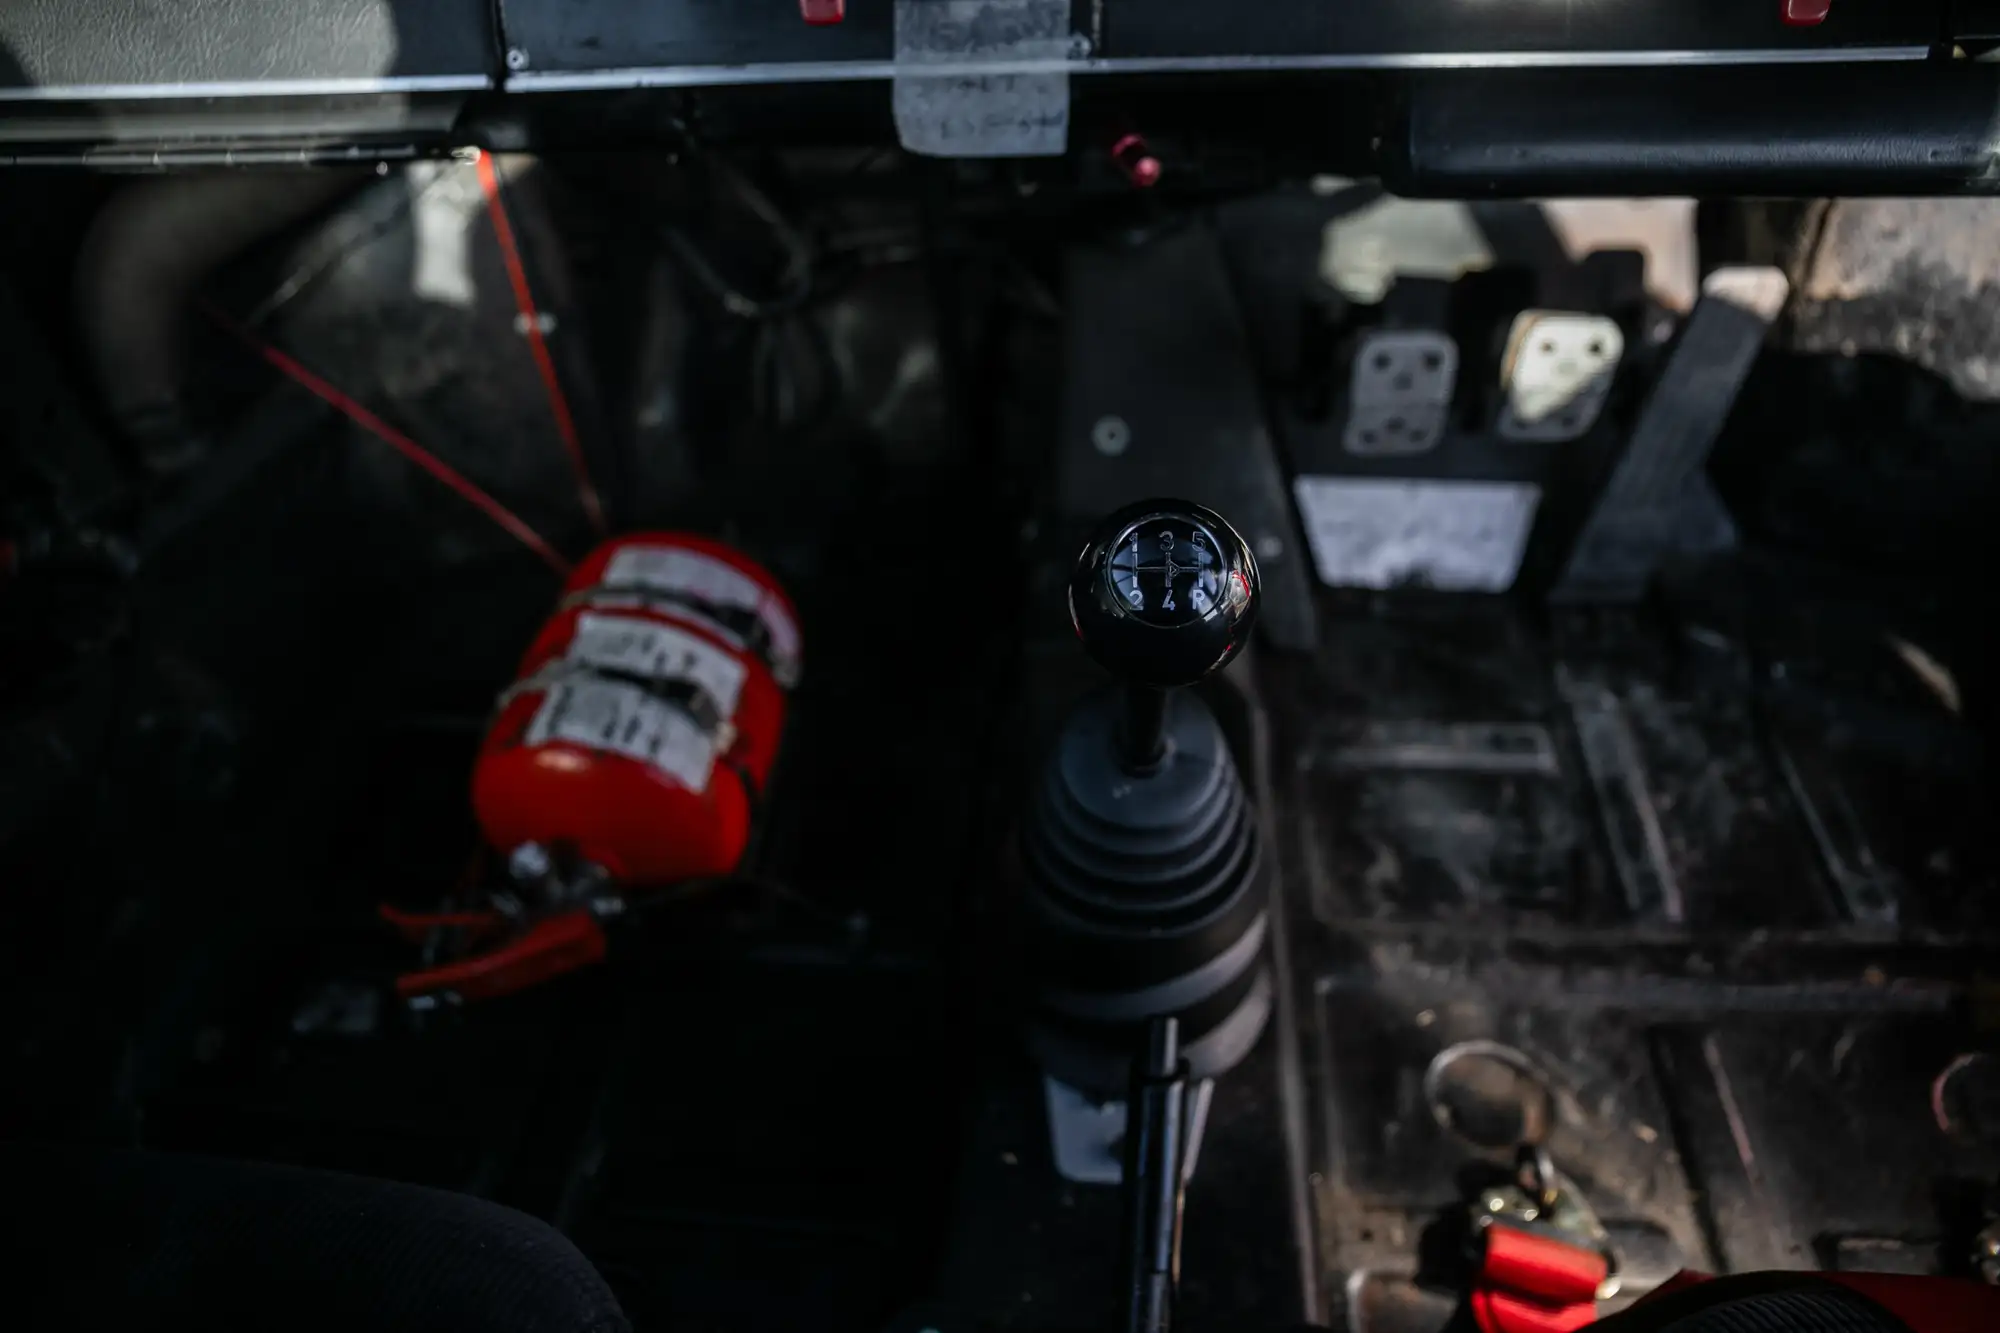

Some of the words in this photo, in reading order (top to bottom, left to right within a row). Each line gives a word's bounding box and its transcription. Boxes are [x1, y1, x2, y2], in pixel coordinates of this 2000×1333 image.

[1129, 532, 1138, 552] 1
[1159, 531, 1174, 551] 3
[1192, 531, 1206, 551] 5
[1129, 590, 1144, 611] 2
[1162, 589, 1176, 611] 4
[1192, 589, 1205, 610] R
